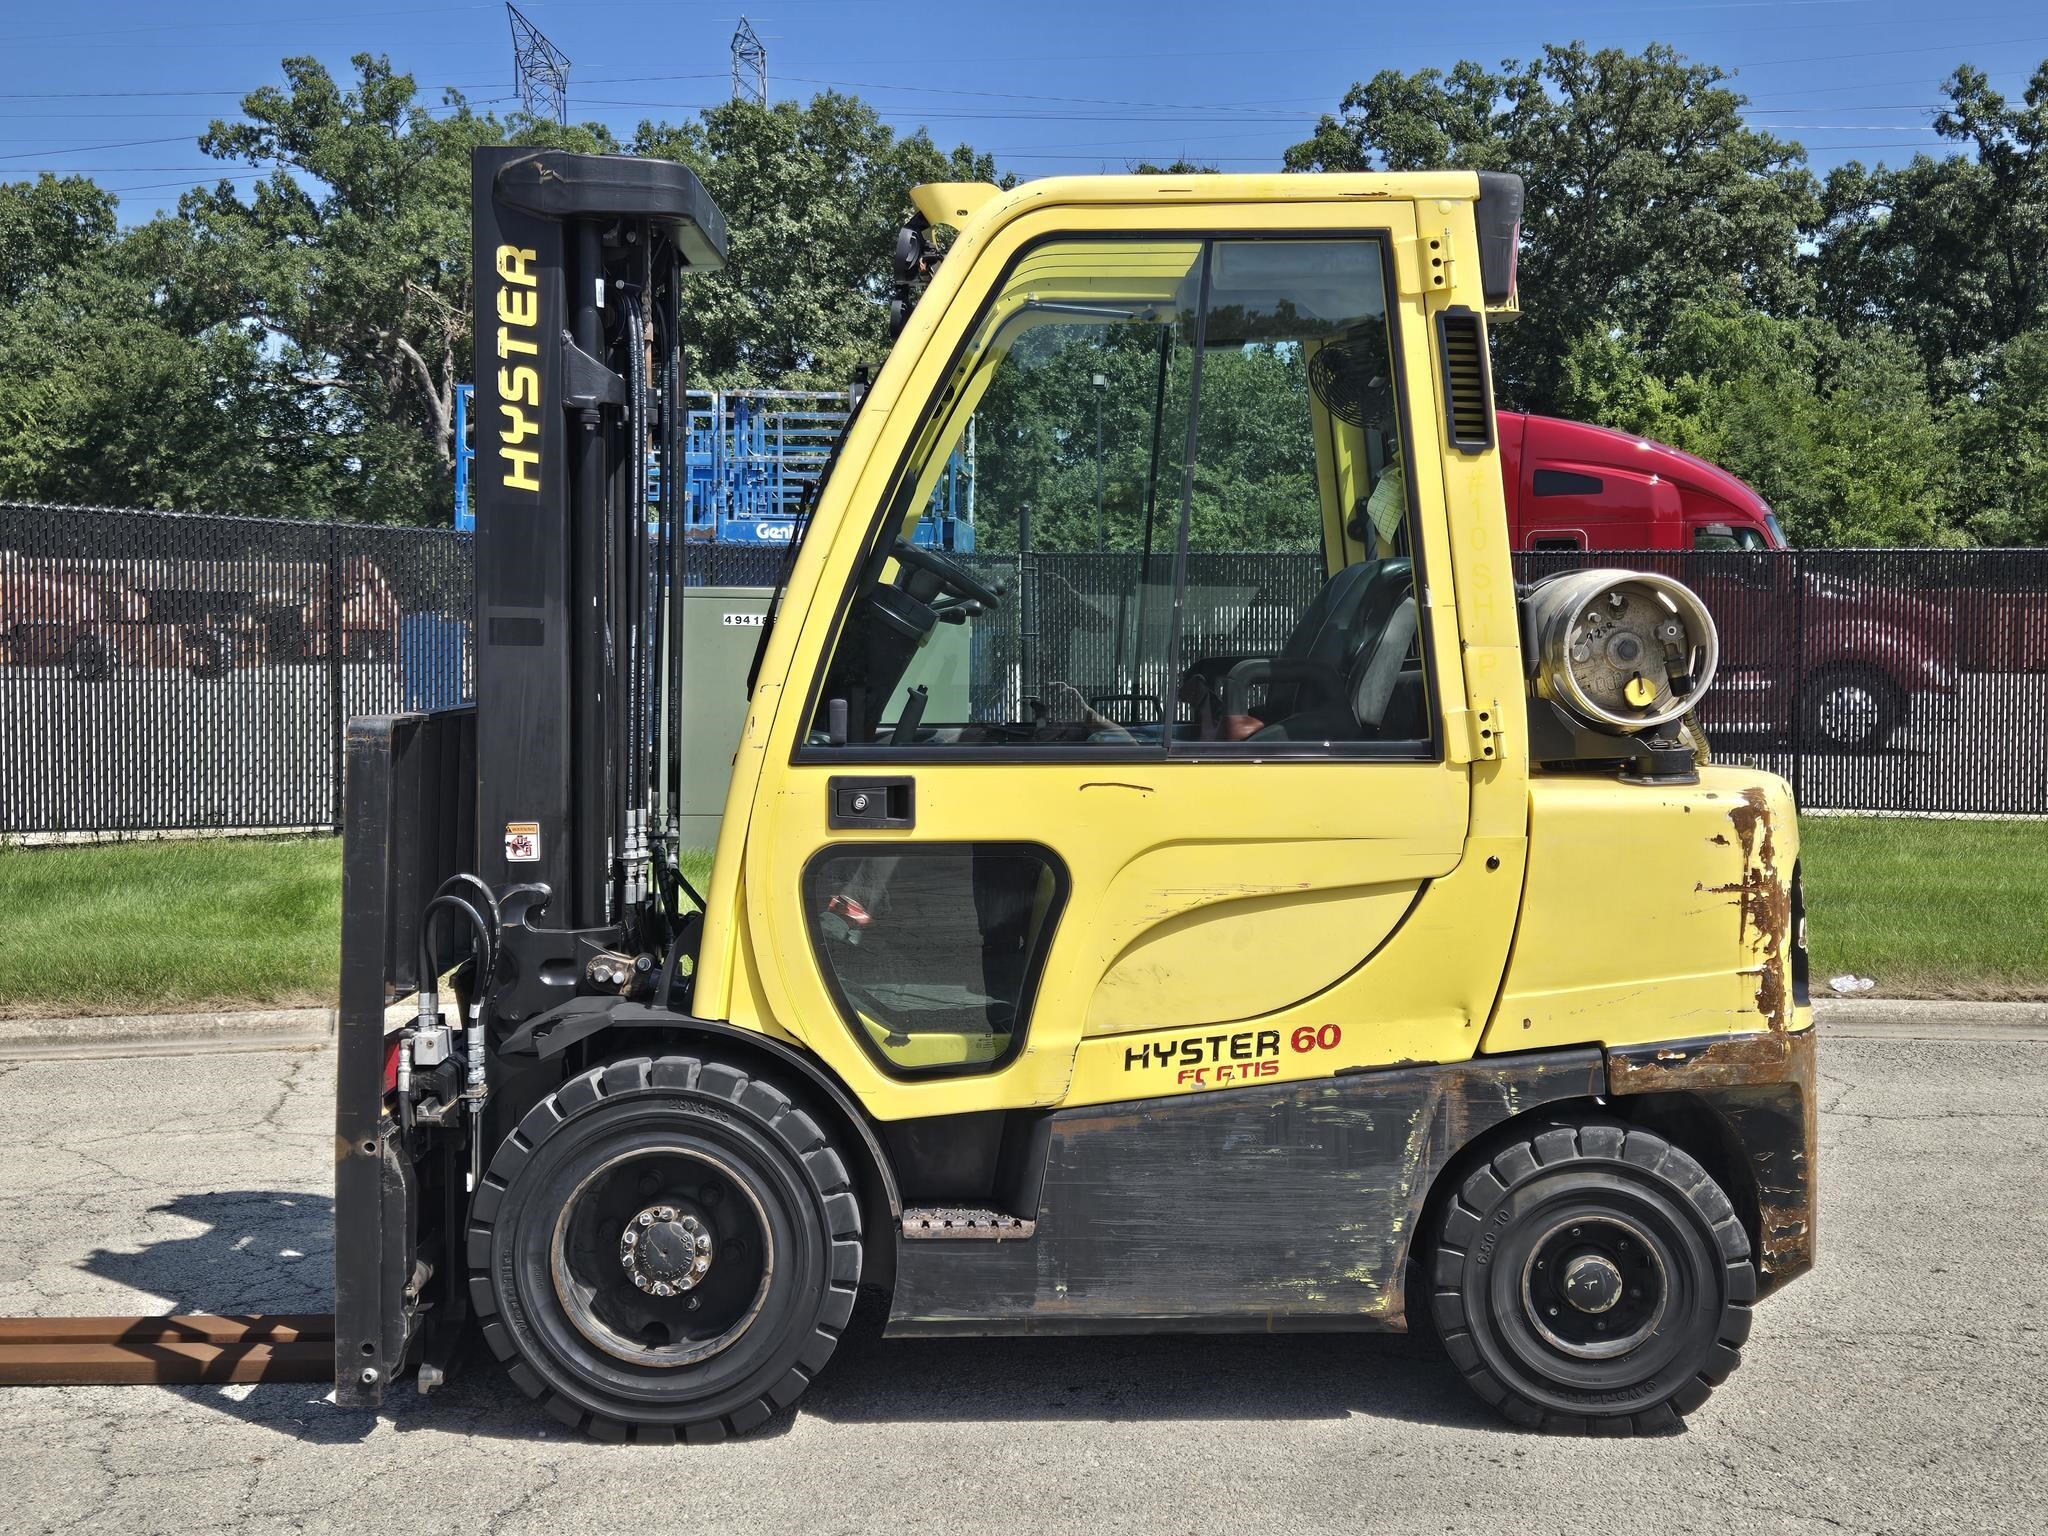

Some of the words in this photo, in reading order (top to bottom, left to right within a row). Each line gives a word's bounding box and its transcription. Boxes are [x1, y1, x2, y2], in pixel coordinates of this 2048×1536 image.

[496, 245, 540, 491] HYSTER
[756, 523, 803, 539] Geni
[1124, 1030, 1280, 1071] HYSTER
[1291, 1024, 1341, 1053] 60
